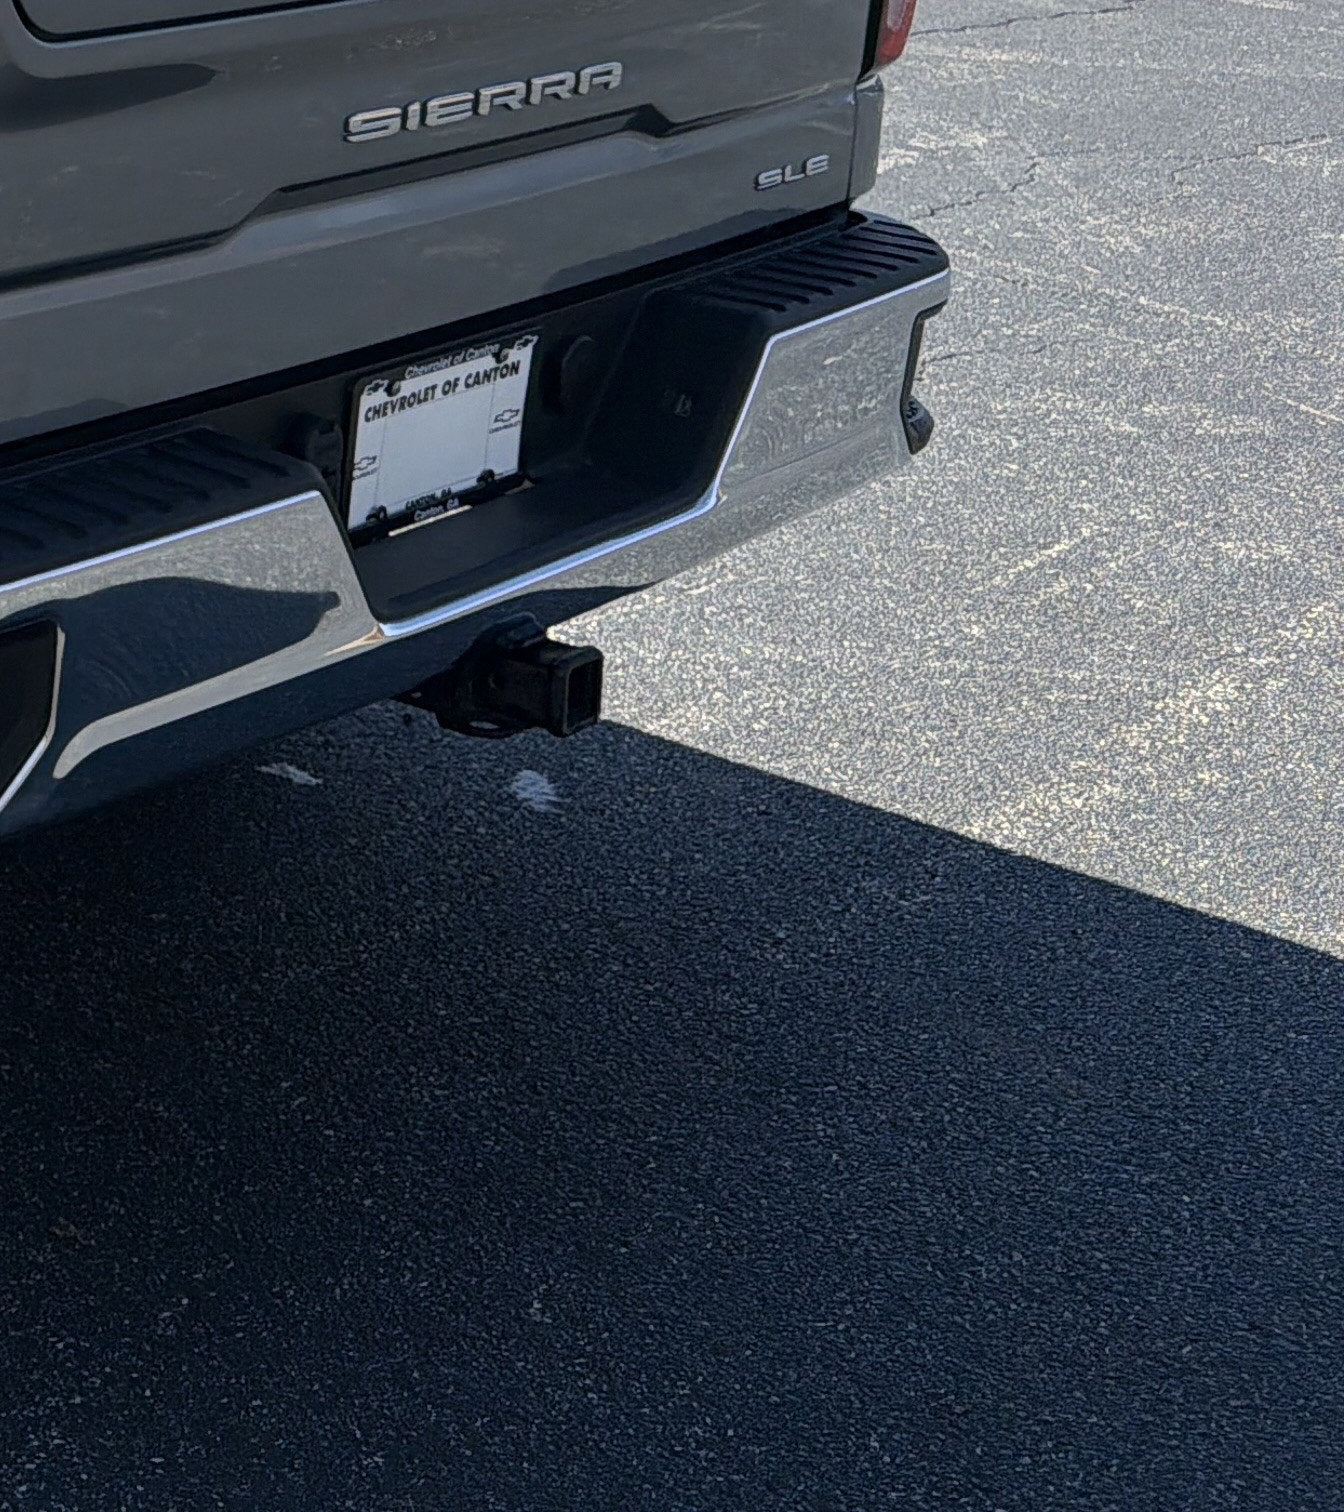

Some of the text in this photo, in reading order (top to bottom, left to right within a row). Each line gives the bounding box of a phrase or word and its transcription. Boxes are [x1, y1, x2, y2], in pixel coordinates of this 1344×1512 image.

[343, 61, 623, 143] SIERRA
[755, 154, 830, 191] SLE
[364, 359, 521, 423] CHEVROLET OF CANTON
